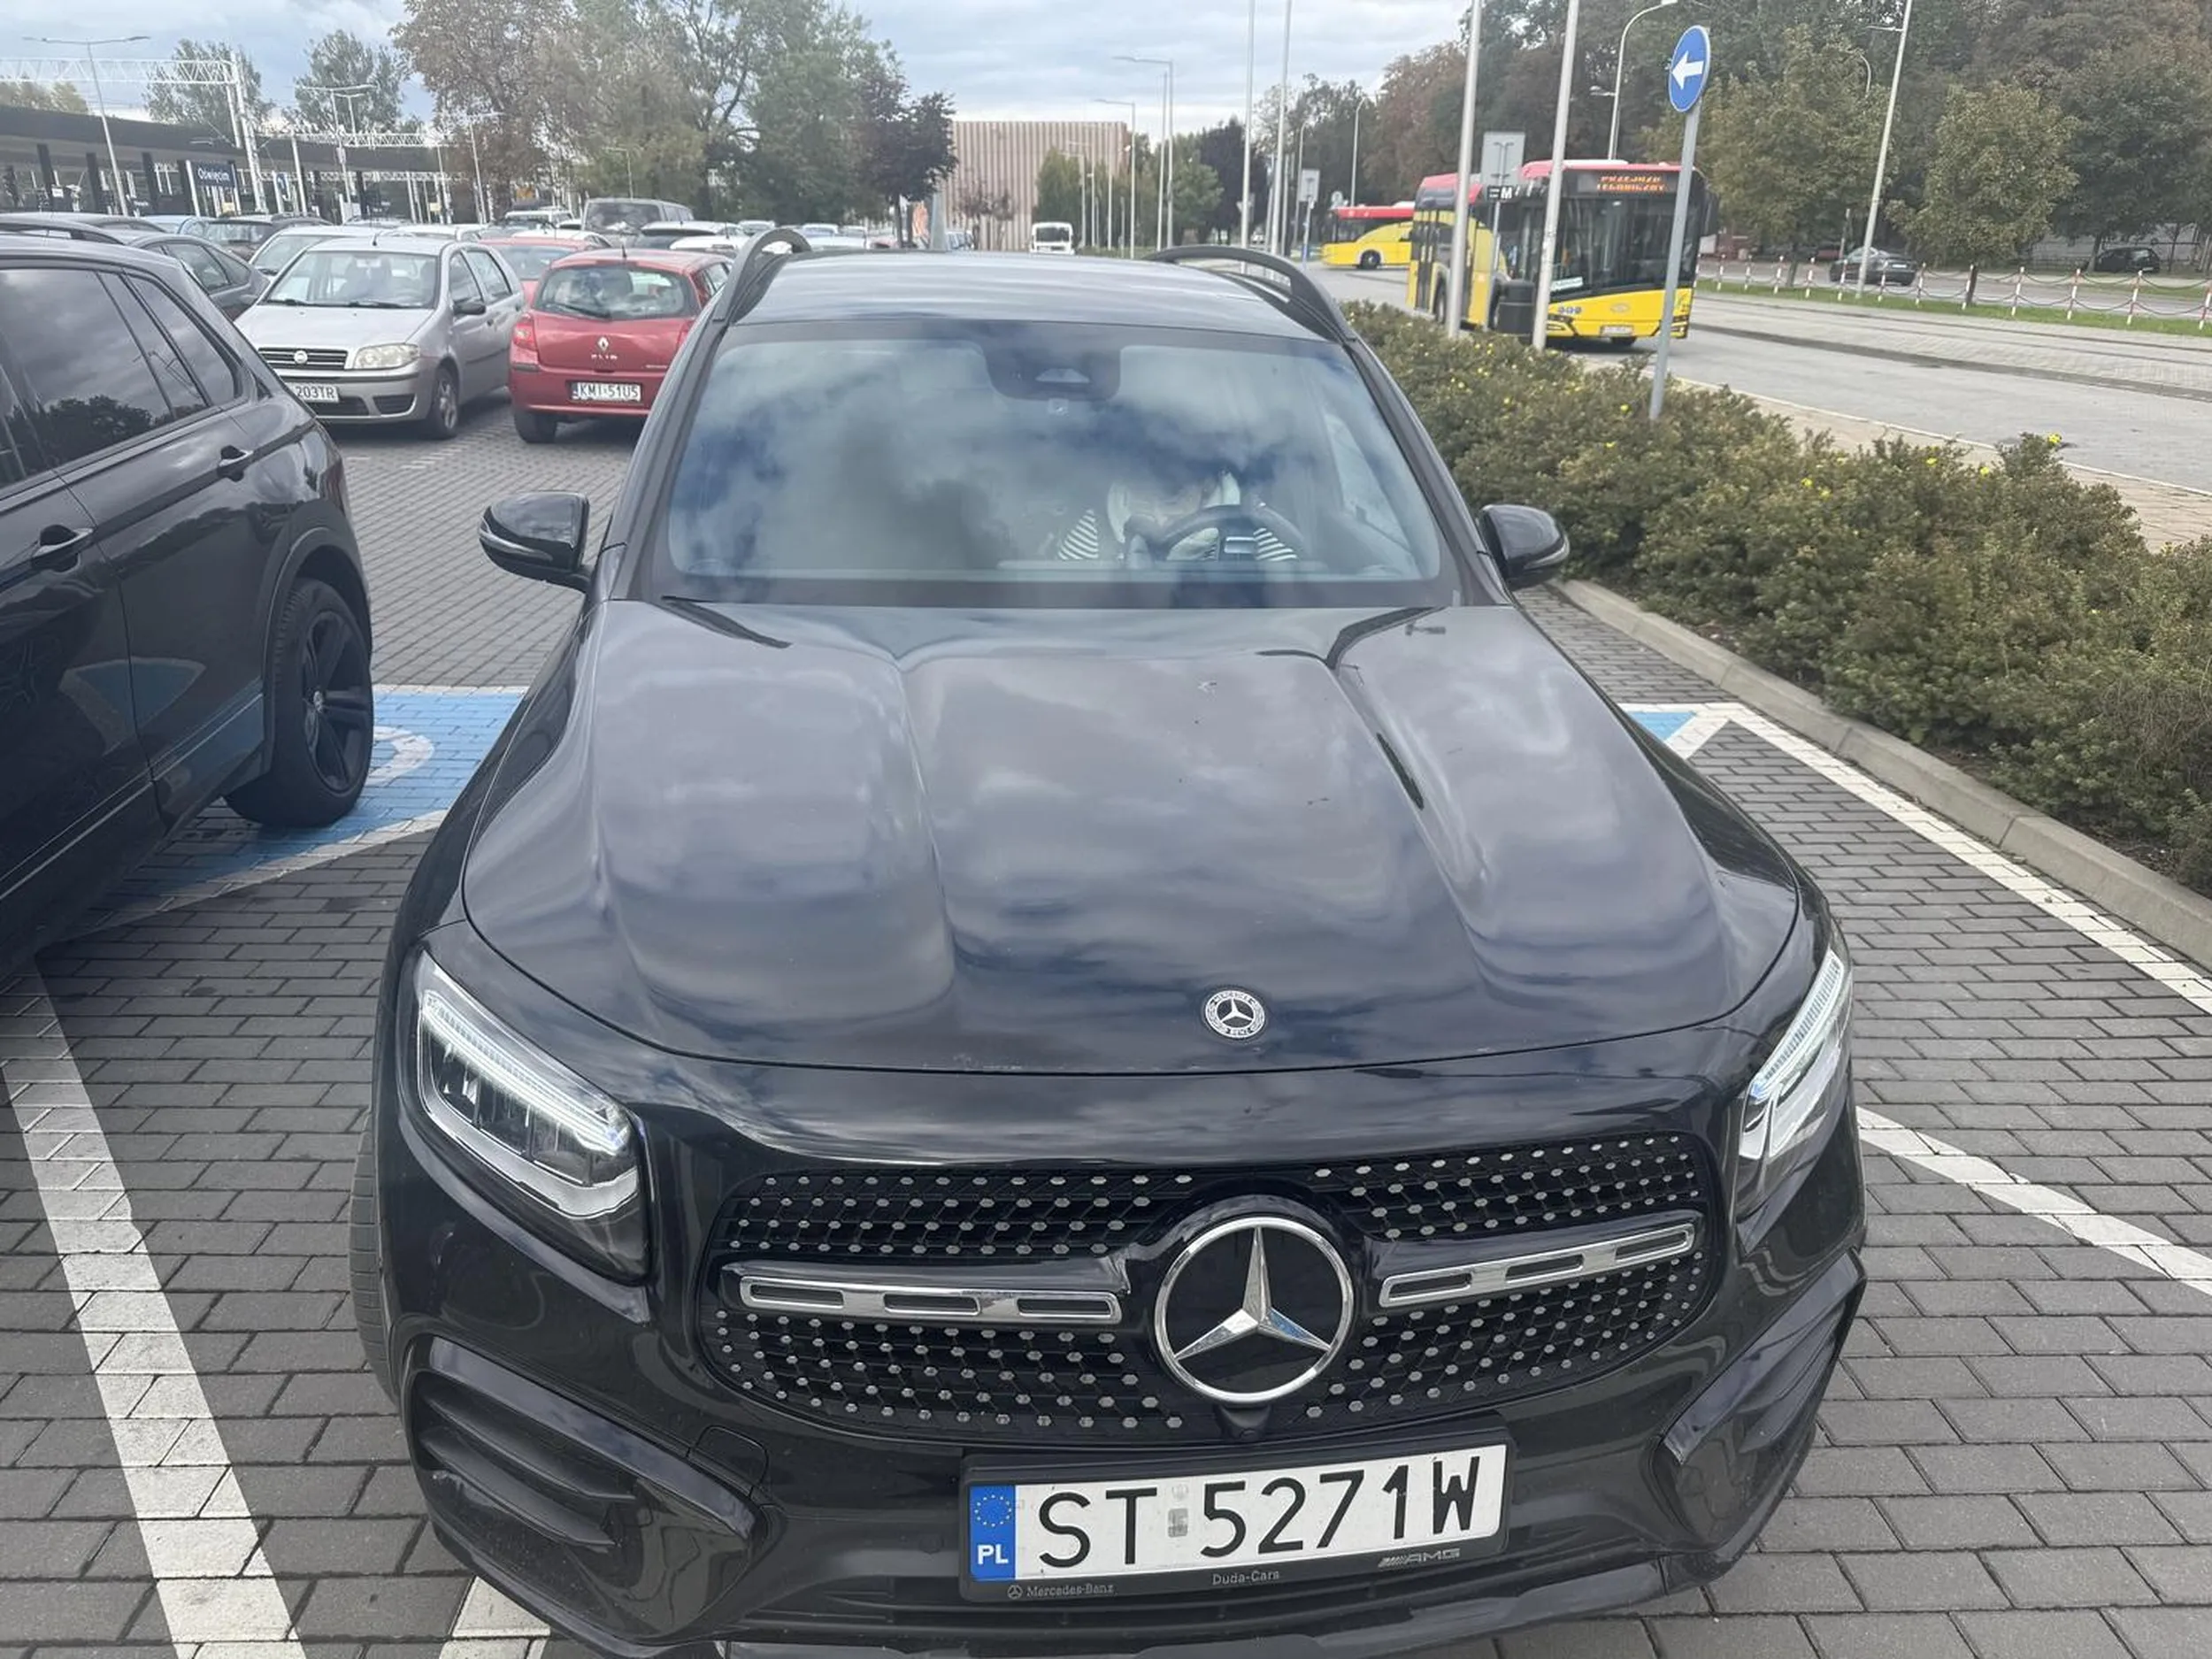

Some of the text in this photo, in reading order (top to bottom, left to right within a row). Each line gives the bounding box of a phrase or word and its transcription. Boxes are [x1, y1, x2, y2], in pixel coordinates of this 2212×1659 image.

[1039, 1455, 1480, 1569] ST 5271W
[977, 1543, 1010, 1565] PL
[1212, 1570, 1280, 1586] Duda-Cars
[1026, 1583, 1116, 1598] Mercedes-Benz
